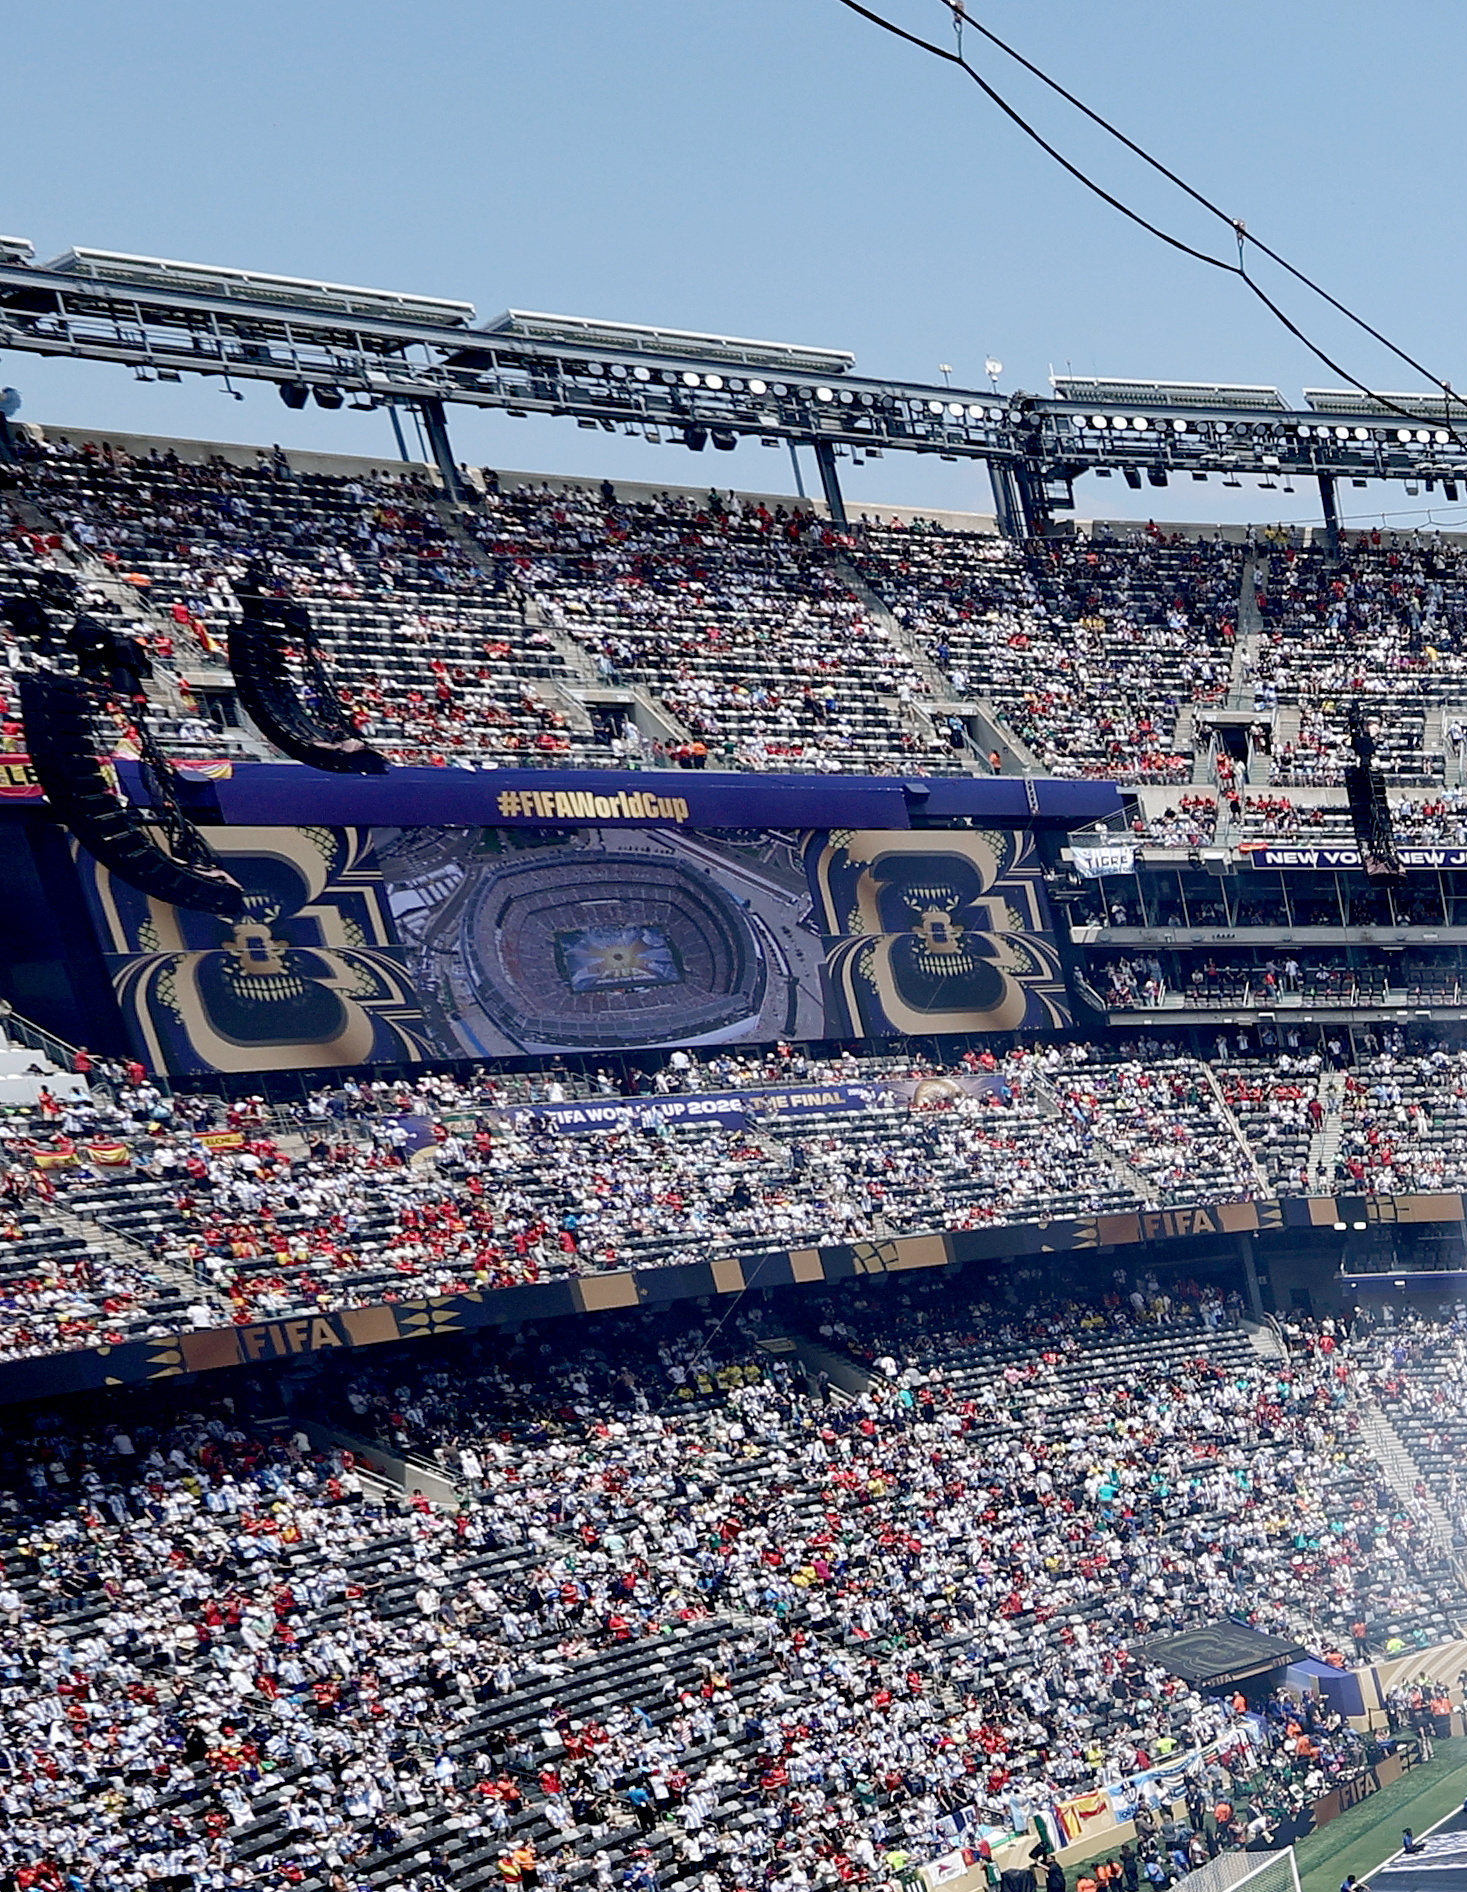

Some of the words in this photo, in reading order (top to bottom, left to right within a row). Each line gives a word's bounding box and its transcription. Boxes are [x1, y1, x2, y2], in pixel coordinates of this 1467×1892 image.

[499, 789, 690, 823] #FIFAWorldCup
[1266, 852, 1317, 864] NEW
[1324, 852, 1362, 864] YO
[791, 1092, 846, 1107] FINAL
[1144, 1209, 1216, 1238] FIFA
[245, 1317, 341, 1358] FIFA
[1341, 1771, 1378, 1810] FIFA
